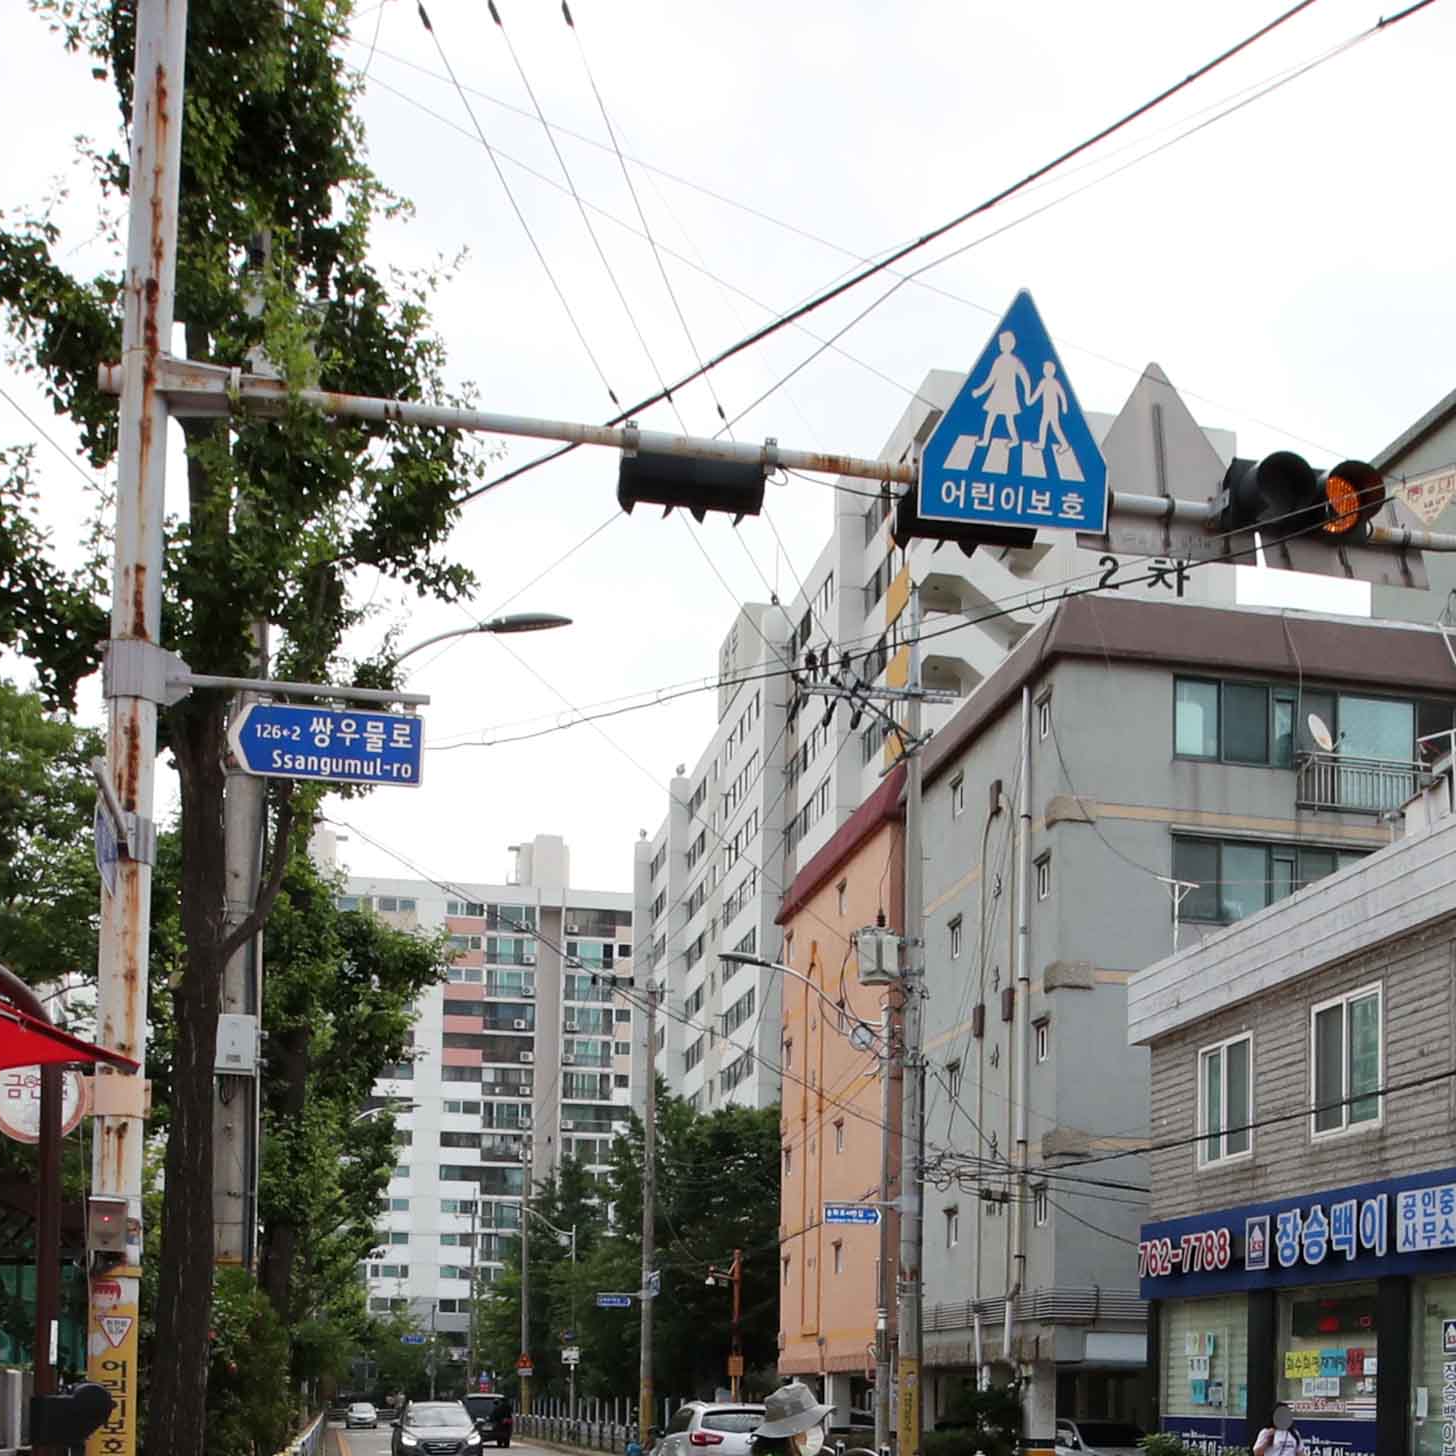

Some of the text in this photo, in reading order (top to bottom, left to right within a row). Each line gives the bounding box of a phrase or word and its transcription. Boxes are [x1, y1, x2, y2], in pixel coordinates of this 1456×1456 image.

[941, 479, 1086, 521] 어린이보호
[1147, 560, 1191, 597] 차
[309, 717, 414, 753] 쌍우물로
[271, 749, 412, 779] Ssangumul-ro
[1275, 1194, 1389, 1268] 장승백이
[1402, 1219, 1456, 1249] 사무소
[1138, 1228, 1231, 1279] 762-7788
